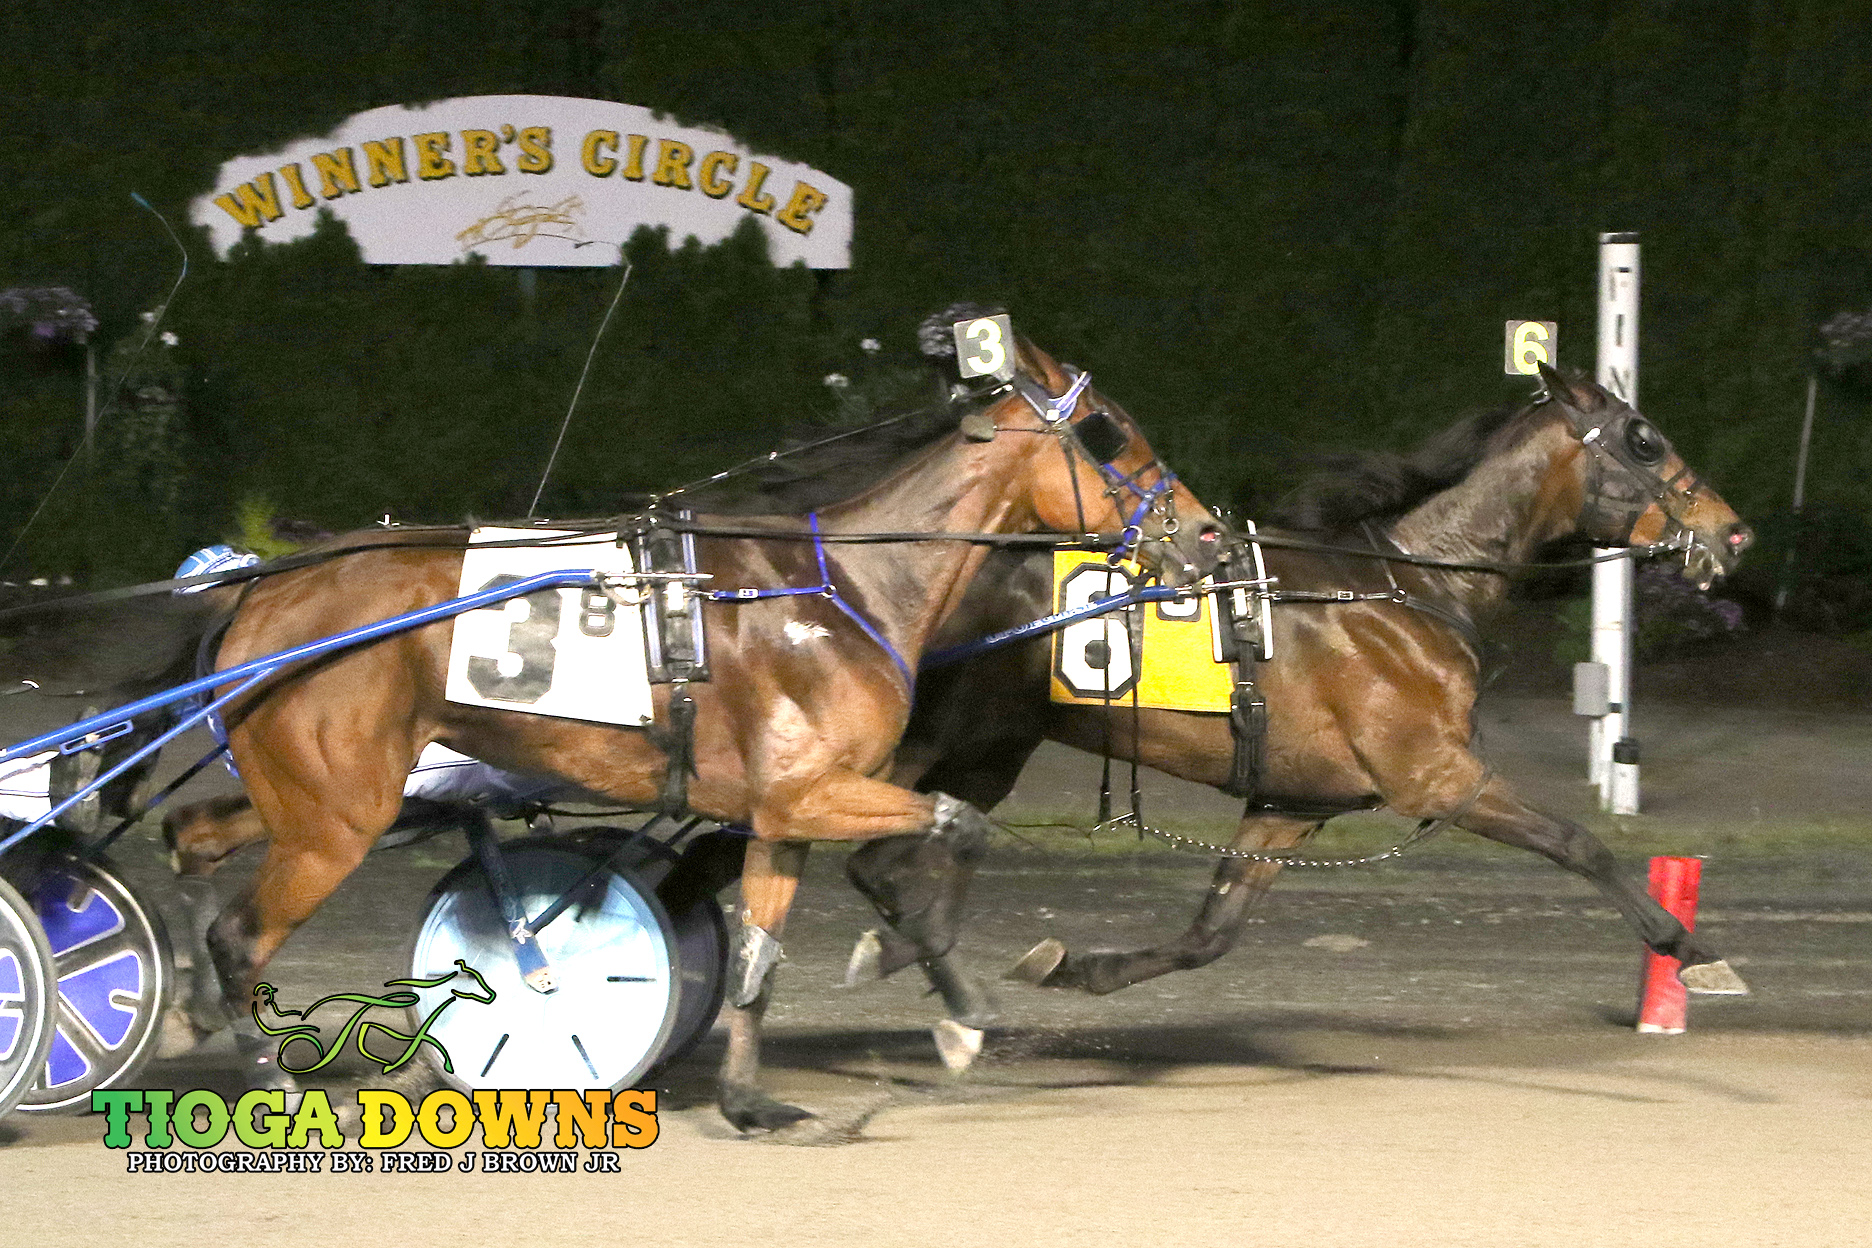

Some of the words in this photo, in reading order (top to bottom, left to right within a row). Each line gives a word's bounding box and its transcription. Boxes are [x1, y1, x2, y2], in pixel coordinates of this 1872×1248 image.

[213, 123, 553, 230] WINNER'S
[580, 128, 829, 236] CIRCLE
[966, 318, 1006, 375] 3
[1513, 321, 1549, 375] 6
[467, 573, 563, 705] 3
[579, 583, 617, 637] 8
